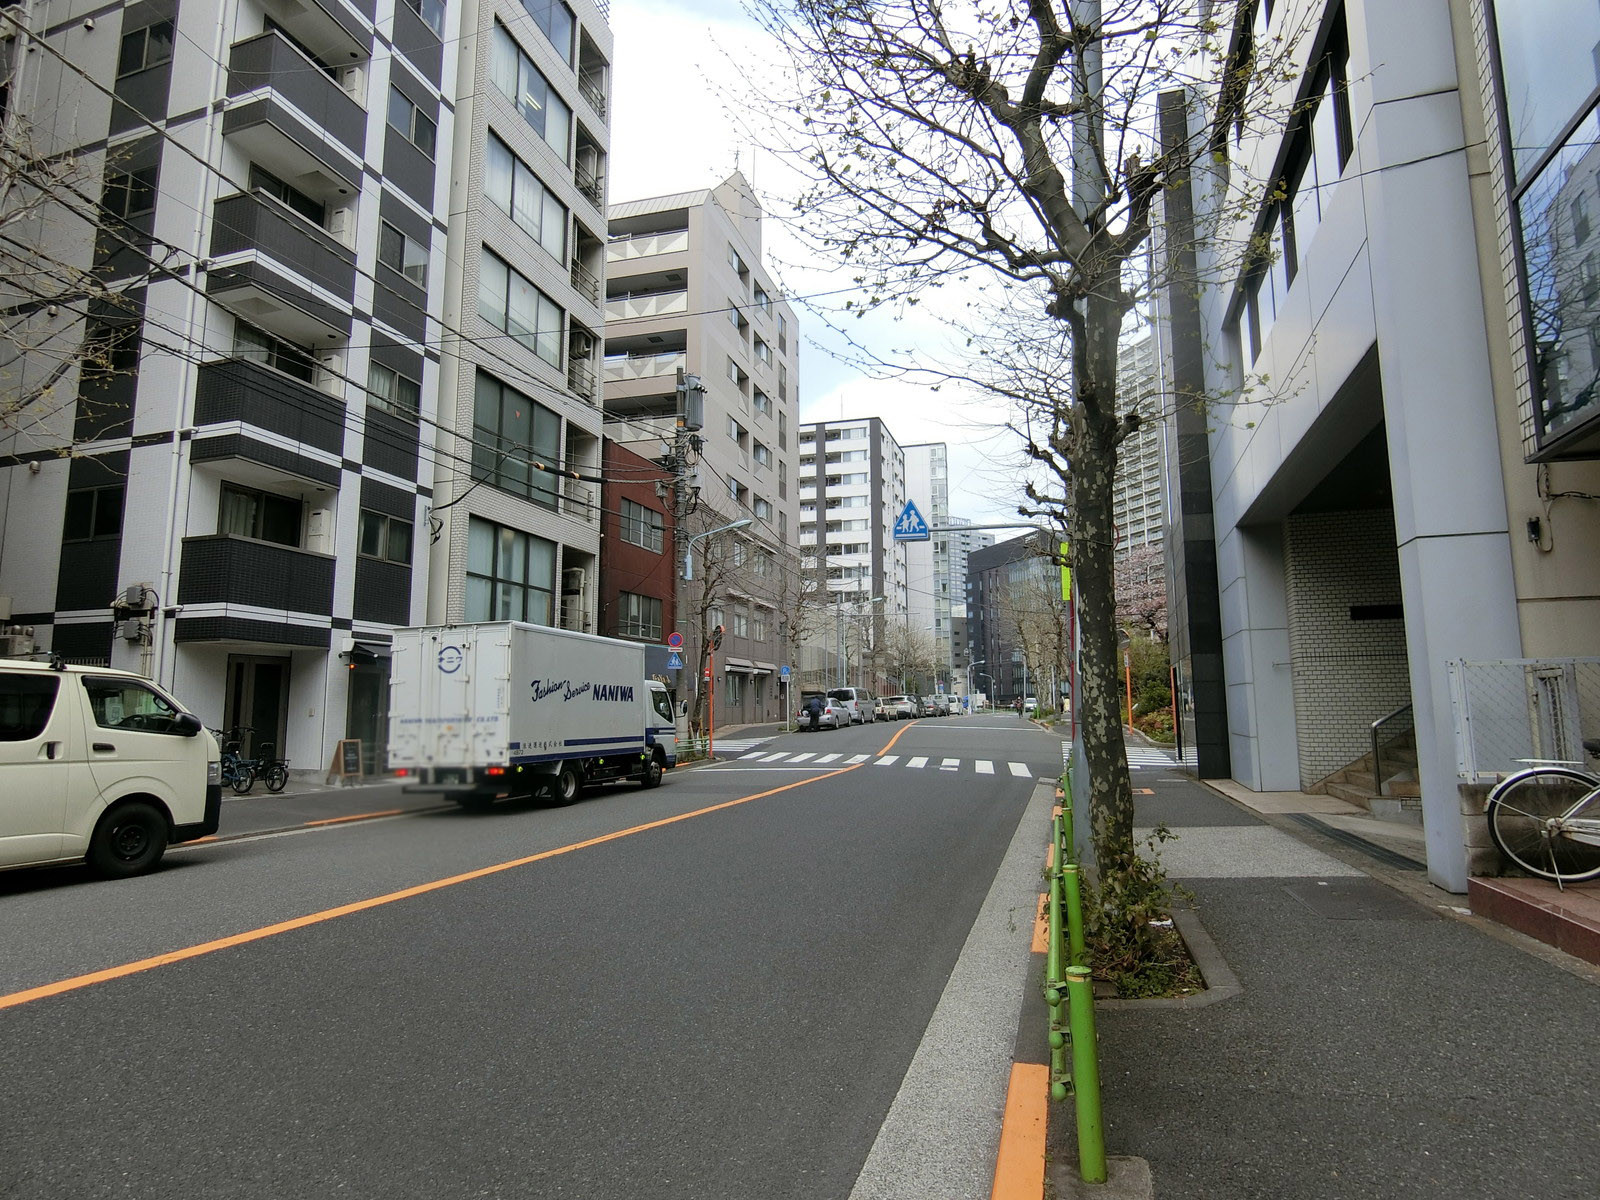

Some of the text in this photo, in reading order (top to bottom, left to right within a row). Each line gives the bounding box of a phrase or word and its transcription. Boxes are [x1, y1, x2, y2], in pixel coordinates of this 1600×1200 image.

[531, 679, 634, 702] Fashion Service NANIWA
